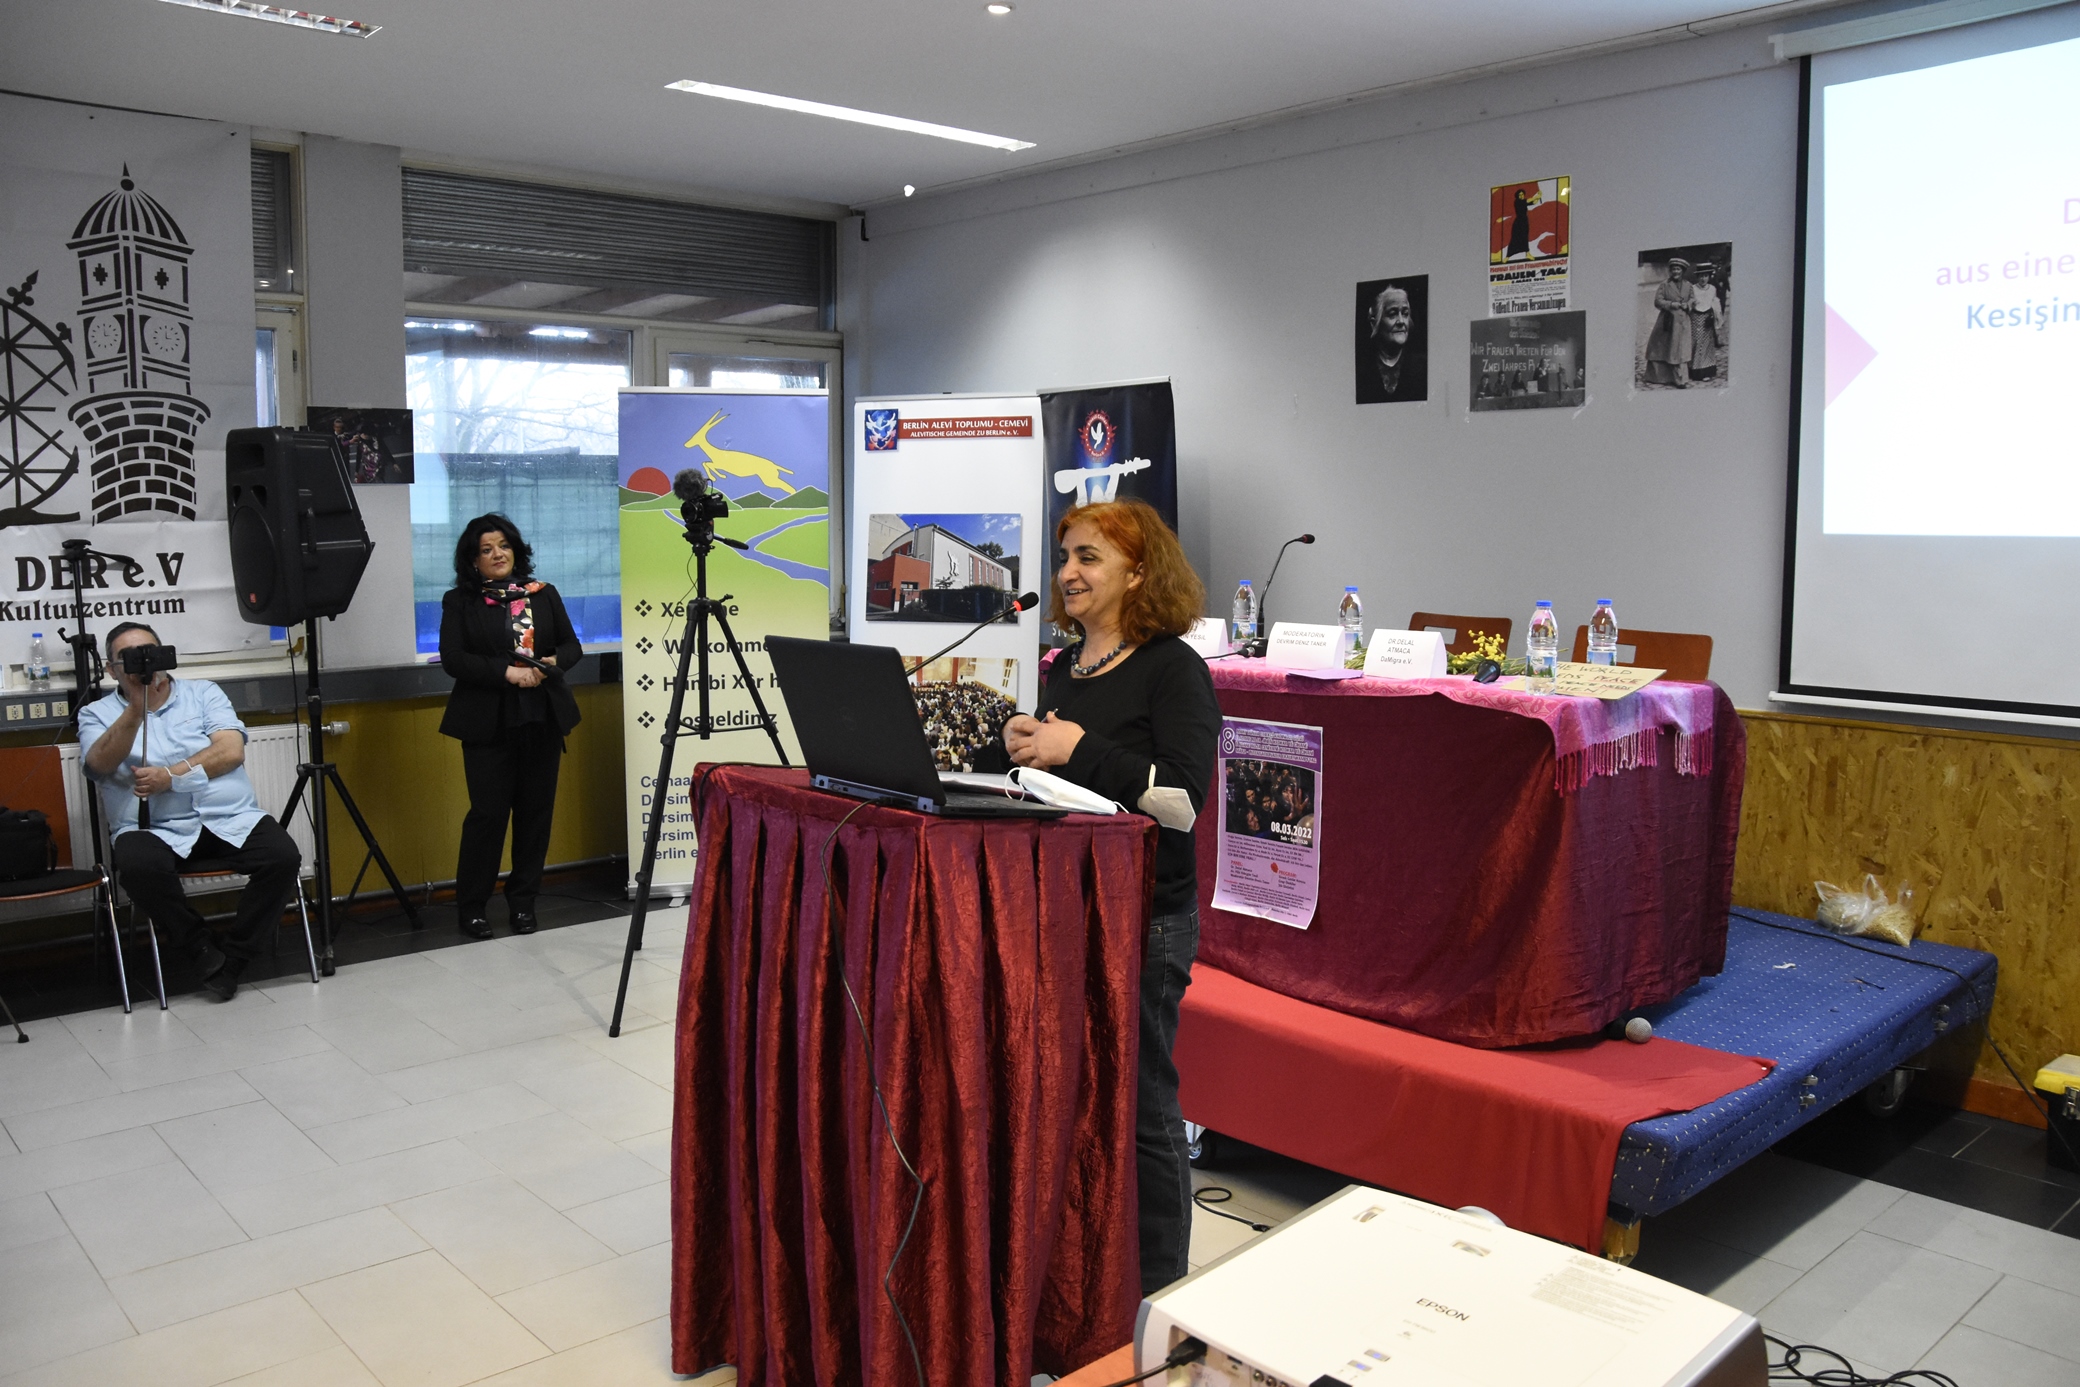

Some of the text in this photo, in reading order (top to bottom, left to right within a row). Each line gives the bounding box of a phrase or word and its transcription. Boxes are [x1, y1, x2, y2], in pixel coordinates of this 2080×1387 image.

[1936, 263, 1990, 286] aus
[1283, 630, 1326, 638] MODERATORIN
[1387, 647, 1411, 655] ATMACA
[1381, 656, 1402, 665] DaMigra
[1222, 727, 1235, 754] 8
[1270, 821, 1312, 839] 08.03.2022
[1416, 1297, 1470, 1321] EPSON
